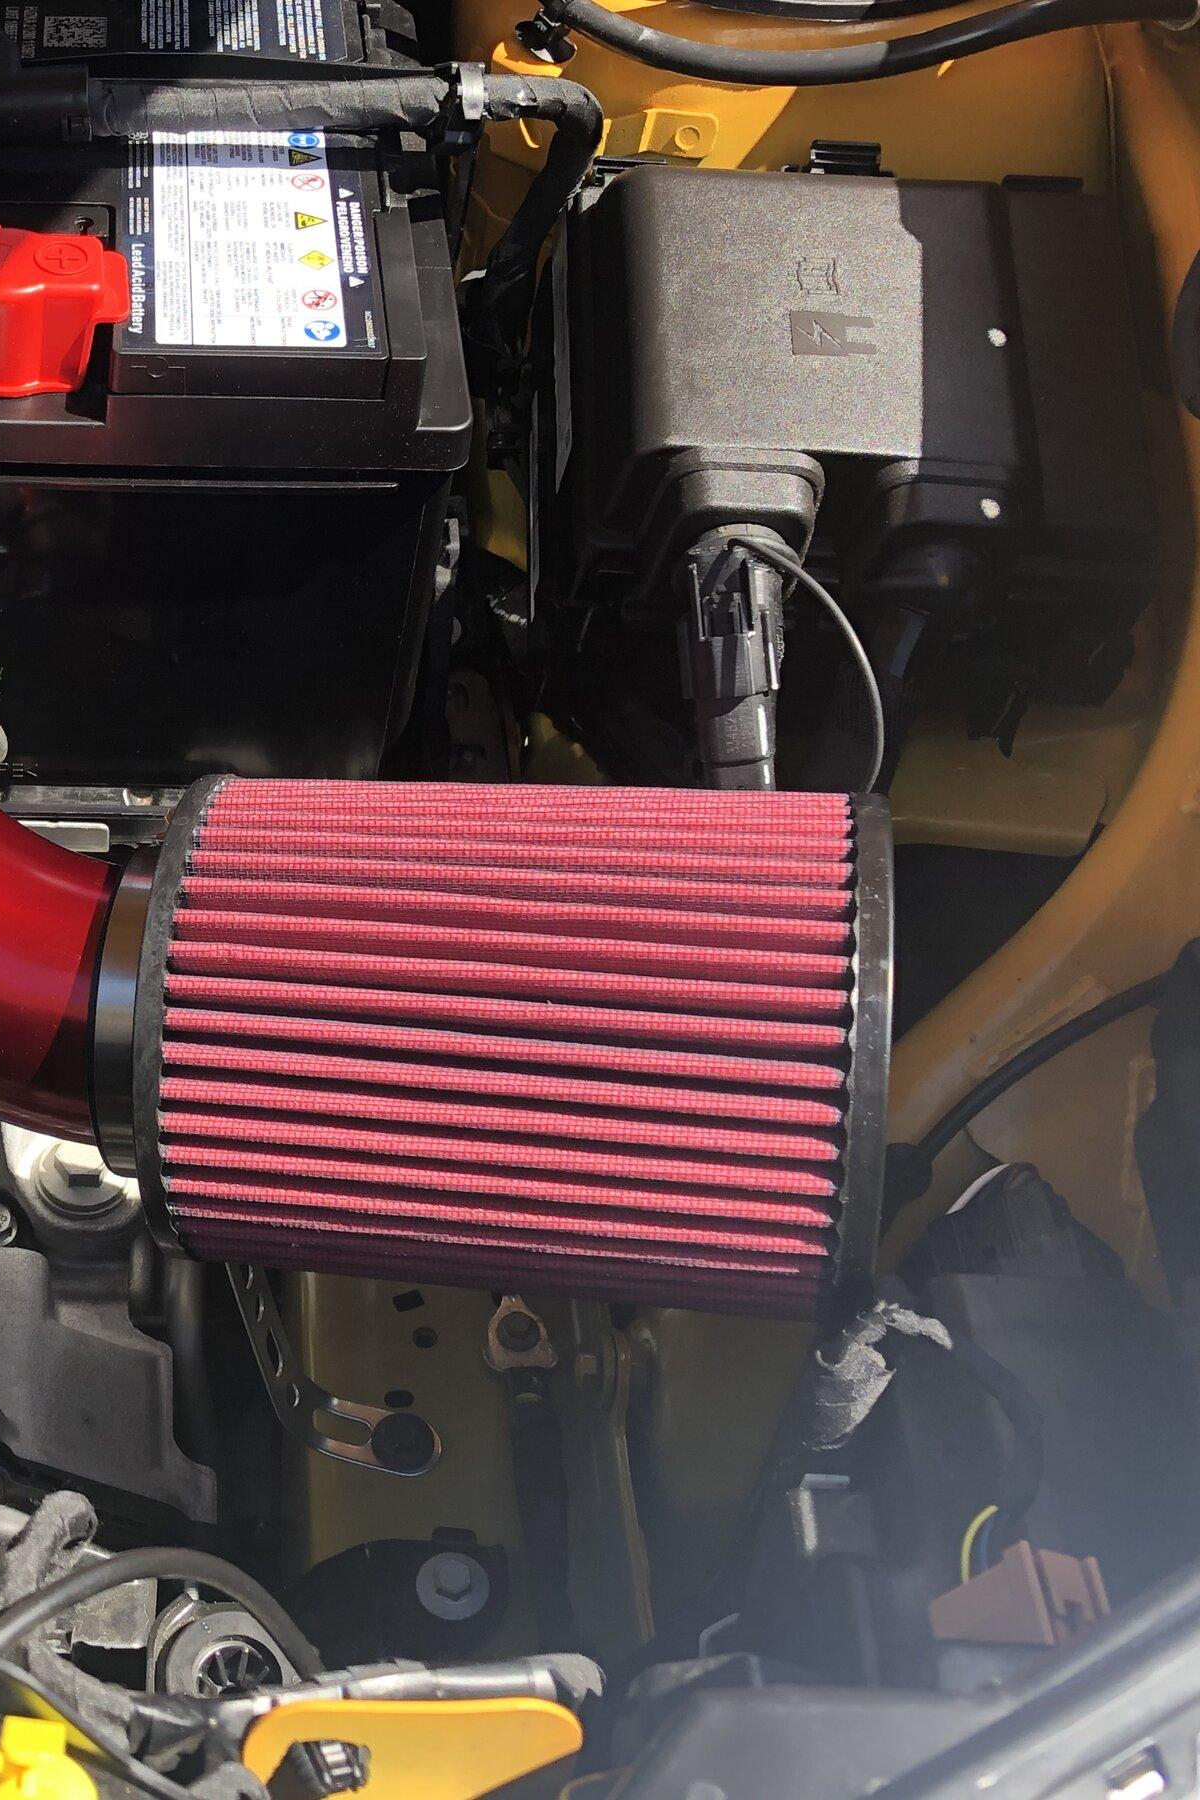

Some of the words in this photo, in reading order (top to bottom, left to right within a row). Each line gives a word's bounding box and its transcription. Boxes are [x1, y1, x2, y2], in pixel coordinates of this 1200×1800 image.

[131, 243, 146, 268] Lead
[336, 201, 354, 273] PELIGRO/VENENO
[349, 201, 368, 274] DANGER/POISON
[132, 269, 146, 293] Acid
[128, 294, 146, 334] Battery
